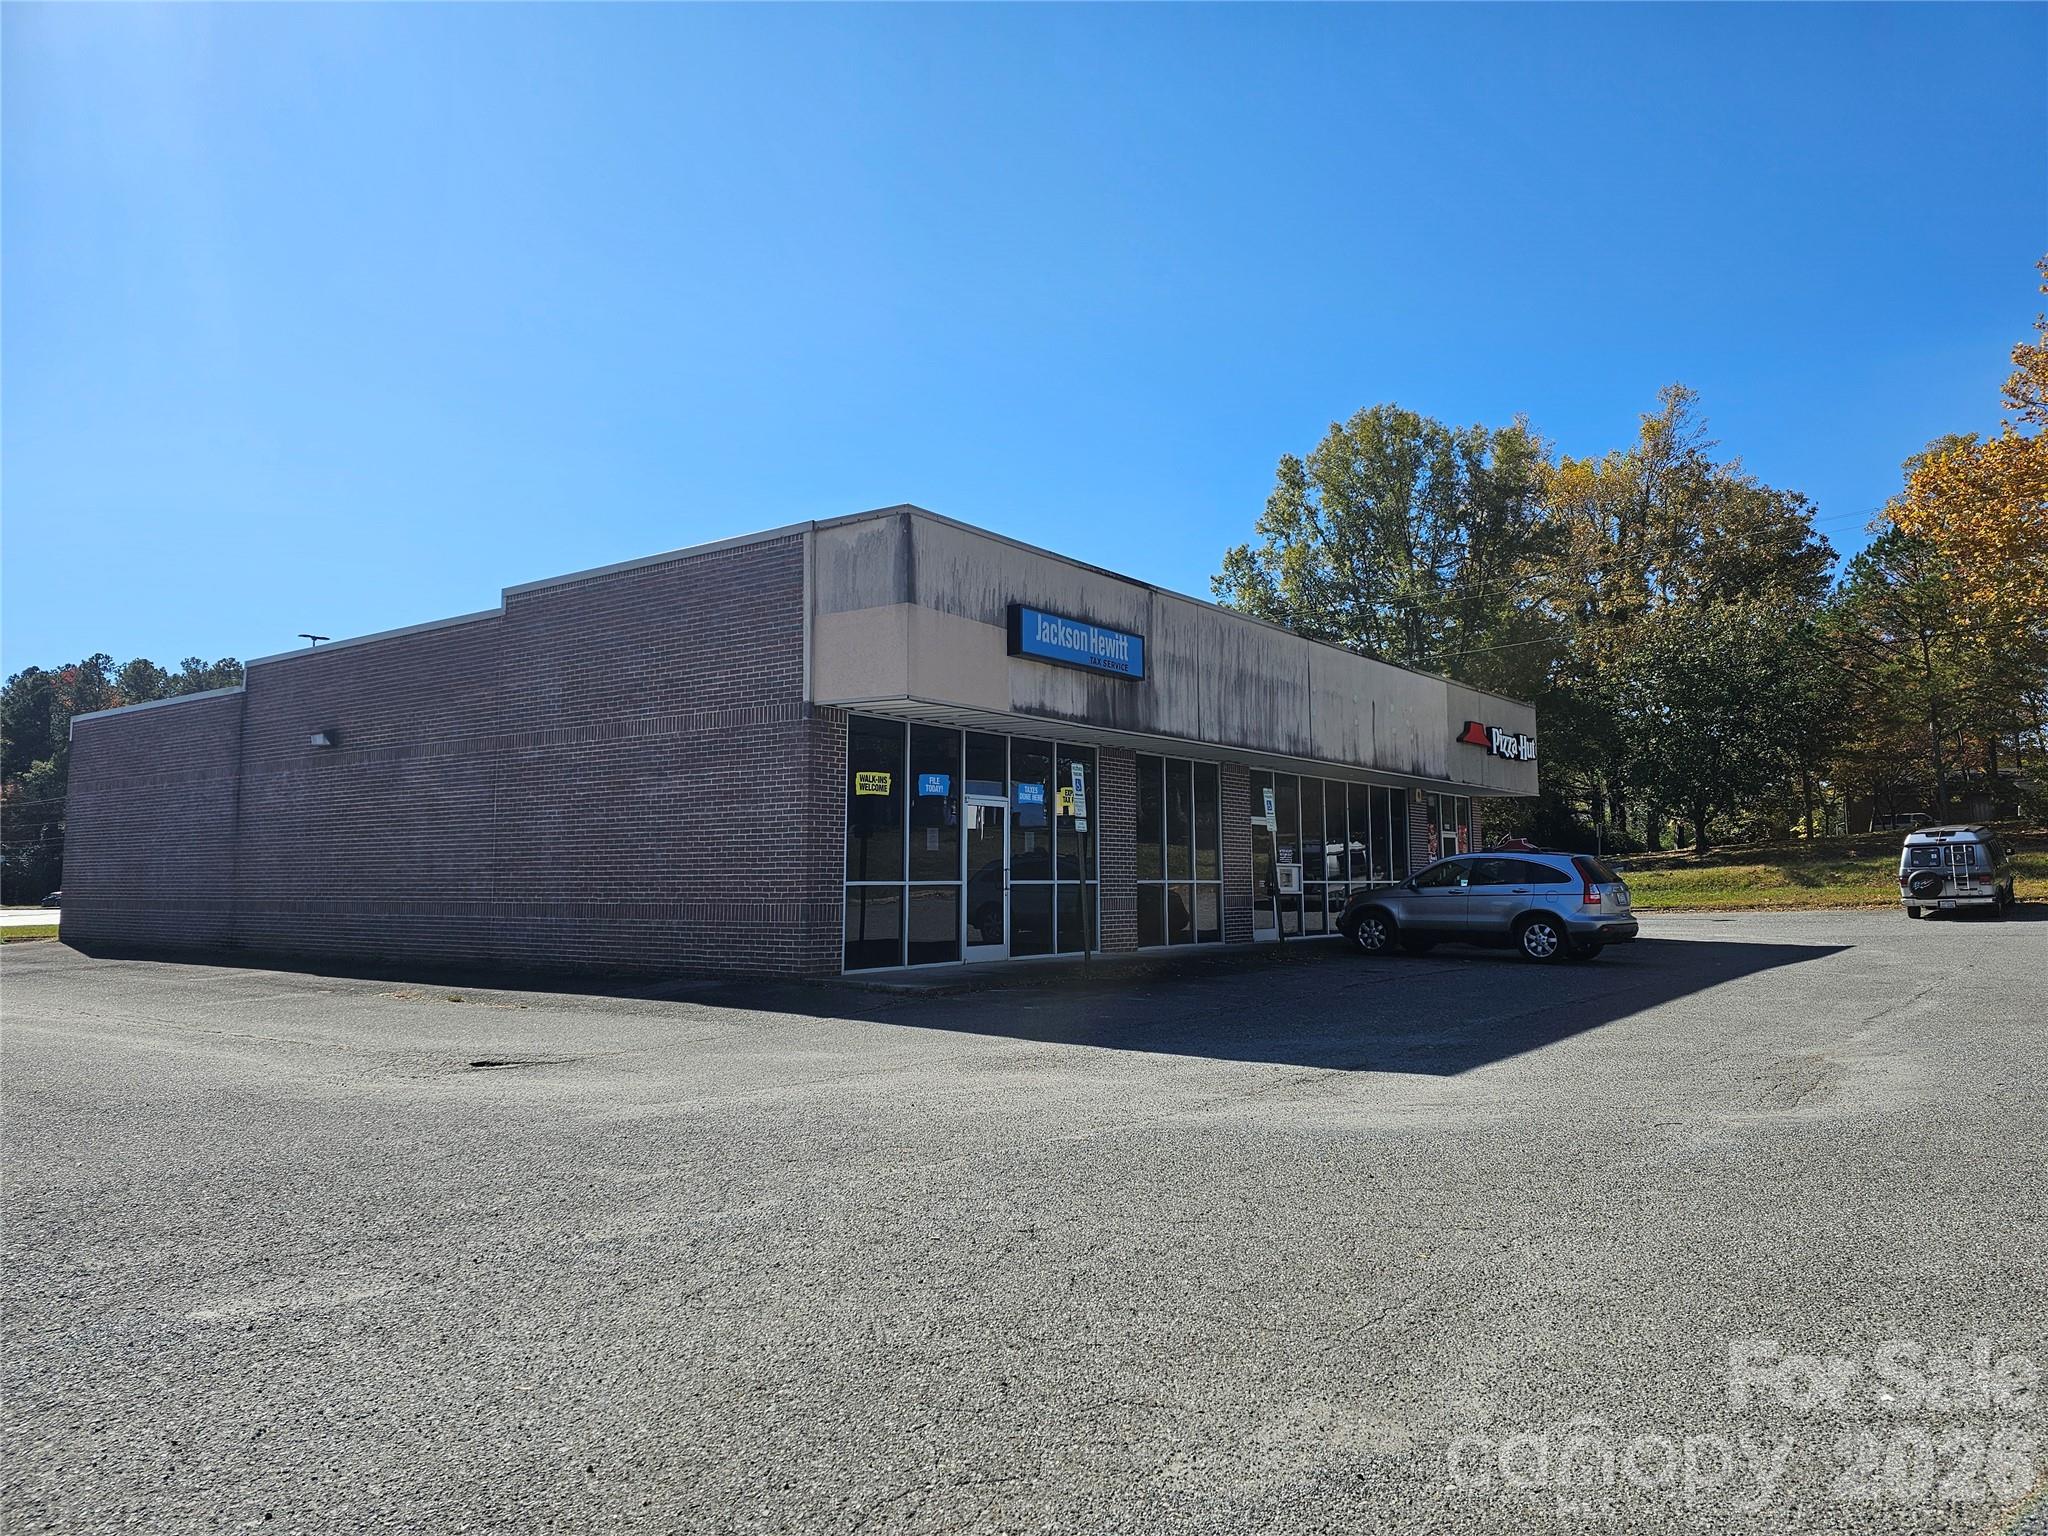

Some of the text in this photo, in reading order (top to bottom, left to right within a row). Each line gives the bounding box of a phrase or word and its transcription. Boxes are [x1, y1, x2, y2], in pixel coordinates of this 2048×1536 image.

[1036, 613, 1129, 661] Jackson Hewitt
[1089, 656, 1129, 672] TAX SERVICE
[1491, 727, 1536, 760] Pizza Hut
[859, 774, 888, 784] WALK-INS
[929, 776, 940, 785] FILE
[859, 782, 888, 792] WELCOME
[925, 784, 944, 793] TODAY!
[1024, 785, 1038, 794] TAXES
